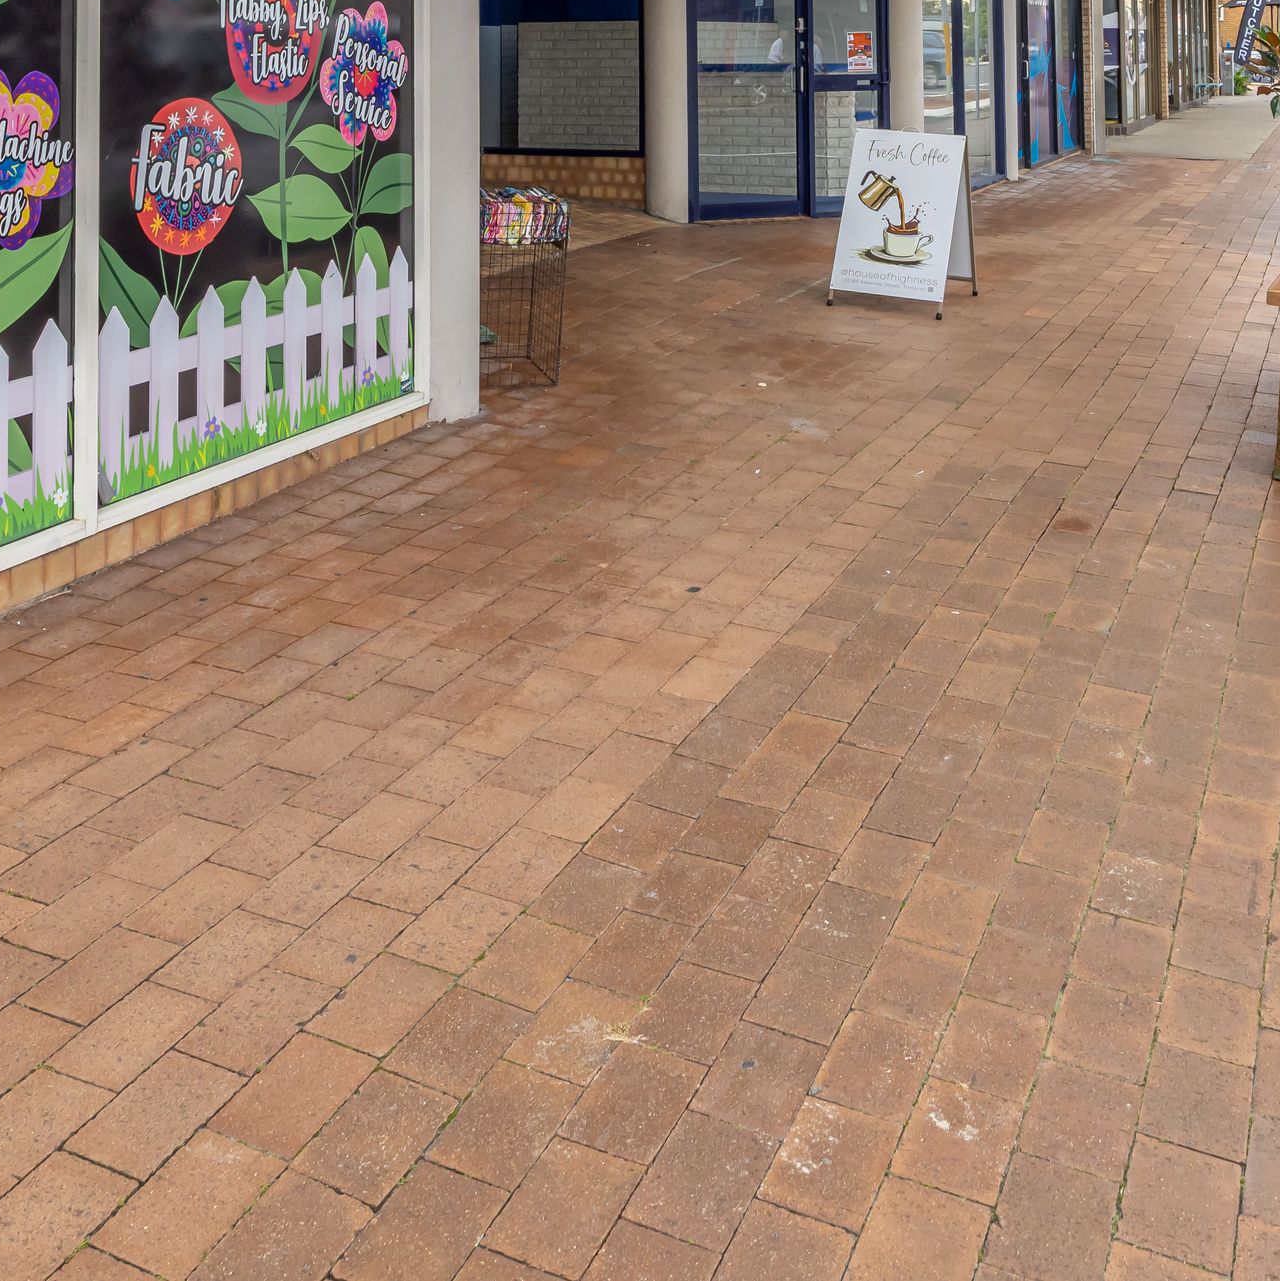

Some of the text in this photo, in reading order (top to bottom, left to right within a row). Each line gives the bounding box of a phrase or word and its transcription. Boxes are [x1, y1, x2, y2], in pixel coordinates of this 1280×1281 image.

[250, 34, 310, 85] Elastic
[330, 12, 409, 88] Personal
[330, 73, 394, 131] Service
[131, 122, 245, 212] Fabric
[868, 140, 949, 167] Fresh Coffee
